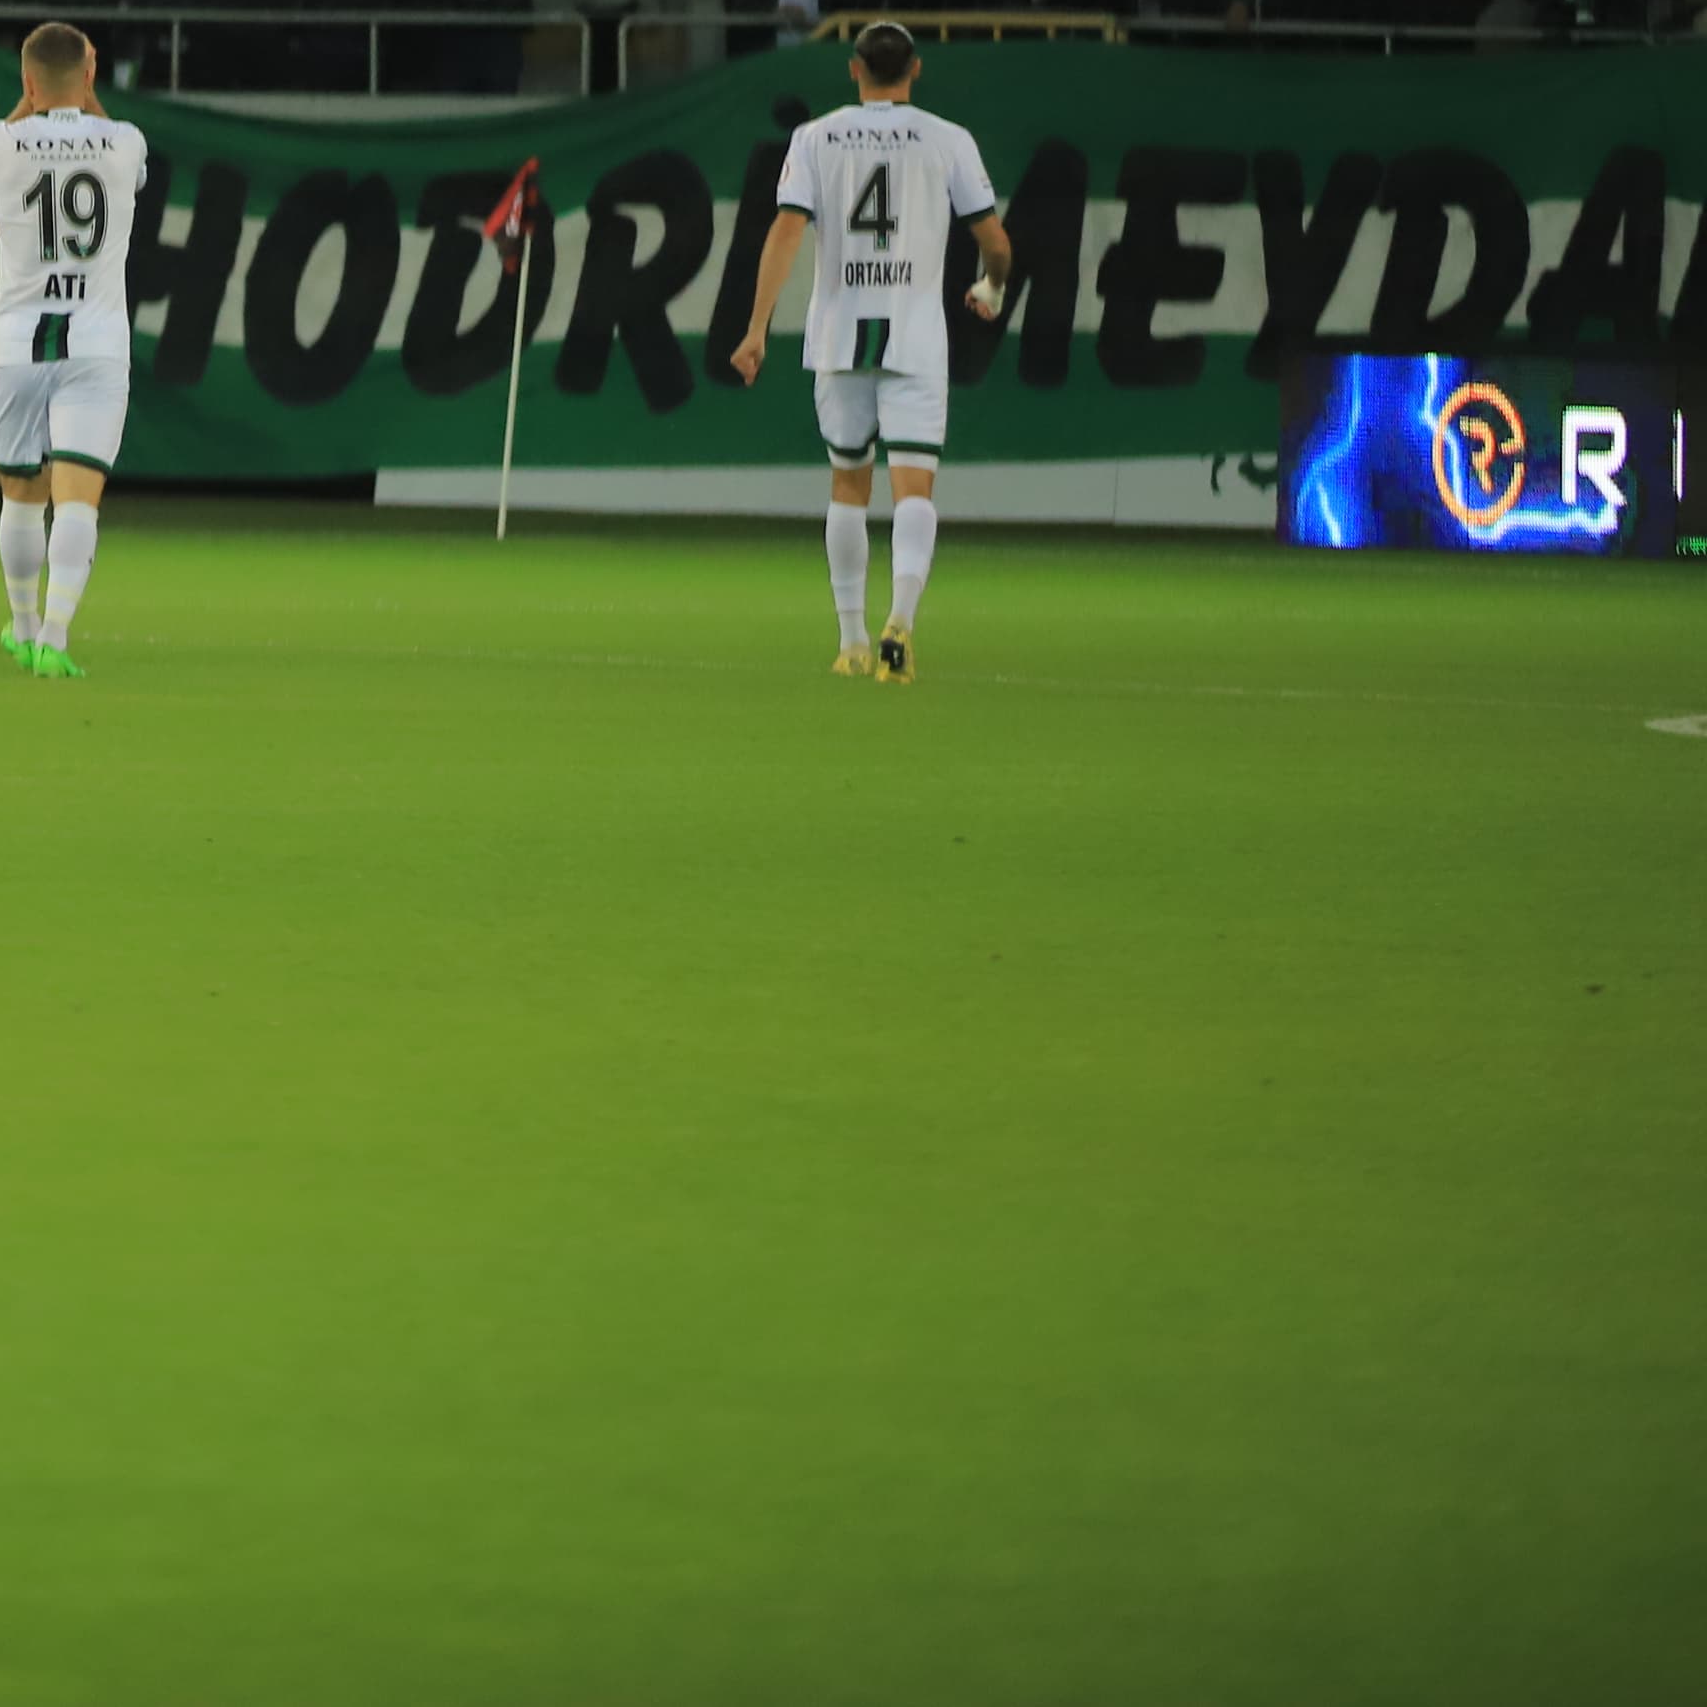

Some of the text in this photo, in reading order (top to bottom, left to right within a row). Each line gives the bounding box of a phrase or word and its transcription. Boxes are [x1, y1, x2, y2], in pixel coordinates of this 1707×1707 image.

[16, 137, 116, 152] KONAK
[827, 128, 922, 144] KONAK
[22, 169, 109, 262] 19
[847, 162, 898, 252] 4
[845, 260, 912, 287] ORTAKAYA
[948, 136, 1707, 387] MEYDA
